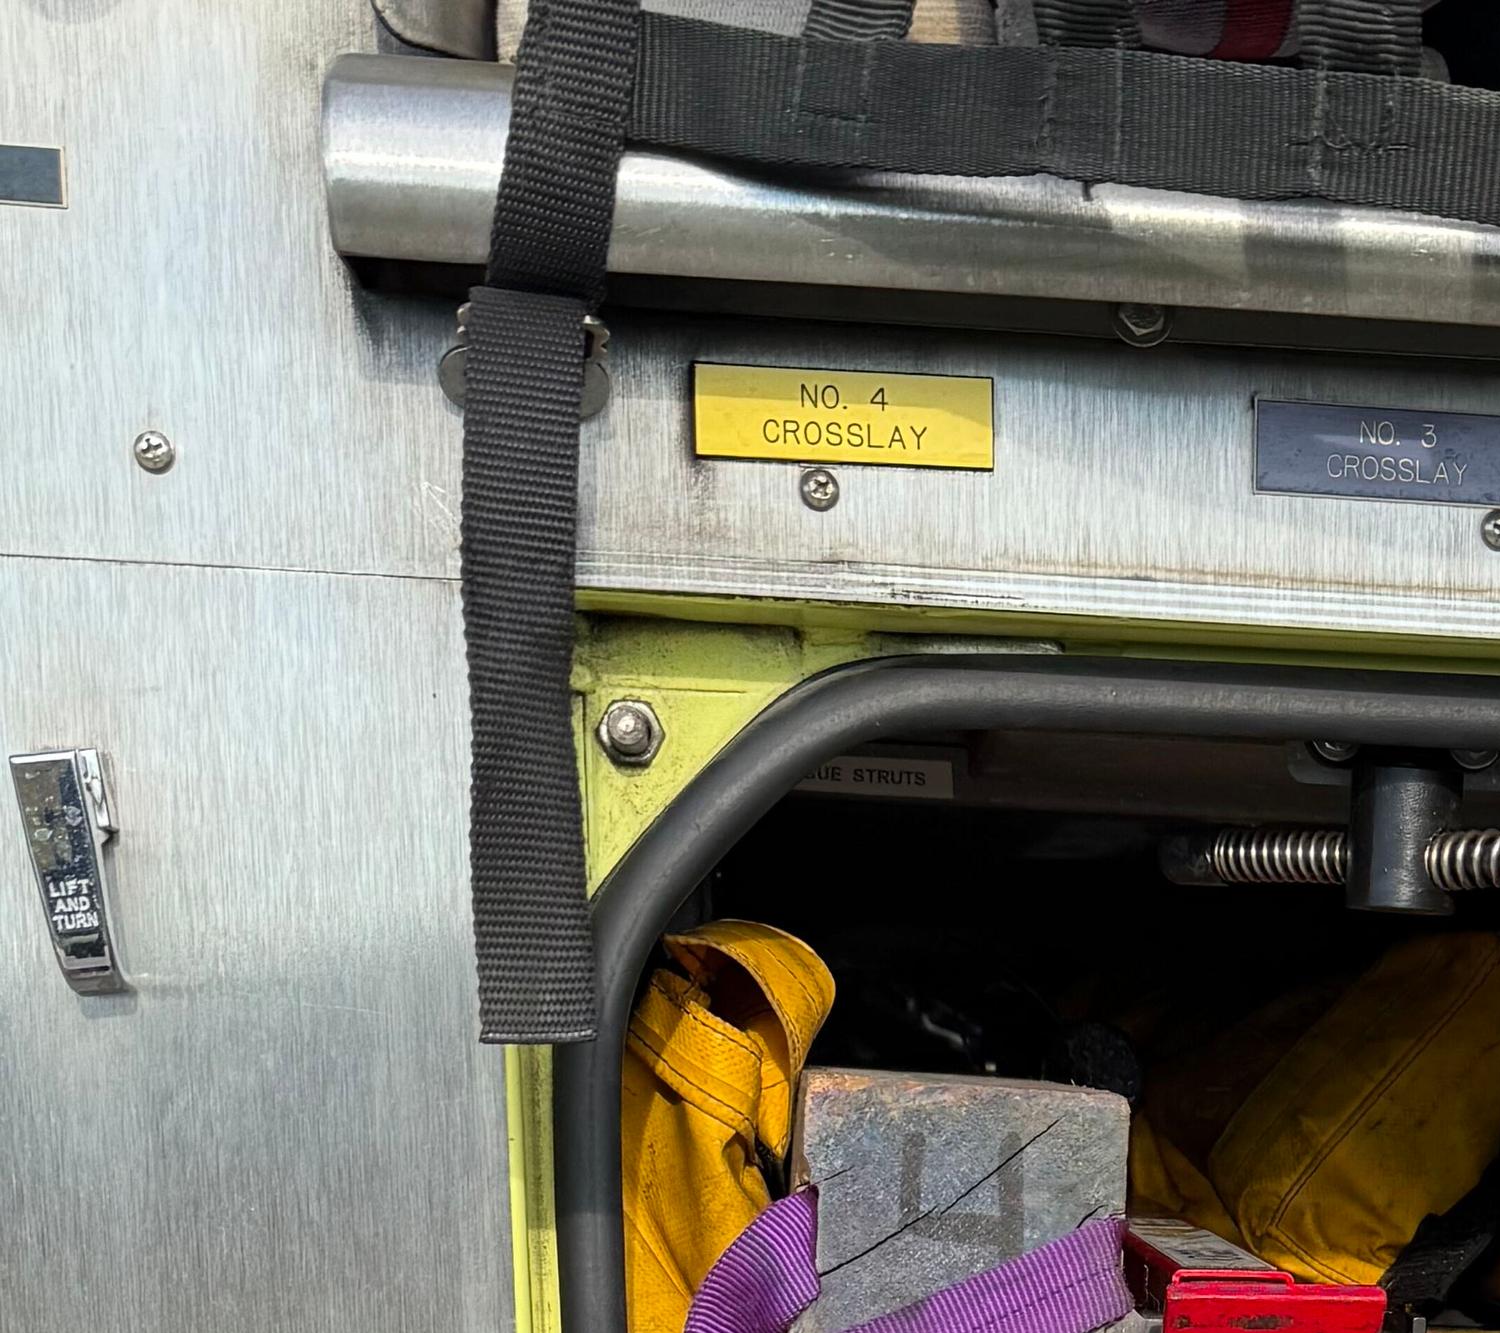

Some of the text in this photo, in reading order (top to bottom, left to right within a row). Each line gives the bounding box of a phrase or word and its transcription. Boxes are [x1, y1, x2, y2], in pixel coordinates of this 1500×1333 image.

[800, 383, 889, 412] NO. 4
[762, 418, 928, 451] CROSSLAY
[1359, 420, 1438, 449] NO. 3
[1326, 453, 1468, 486] CROSSLAY
[852, 768, 927, 787] STRUTS
[48, 878, 90, 897] LIFT
[54, 896, 91, 913] AND
[52, 911, 99, 931] TURN
